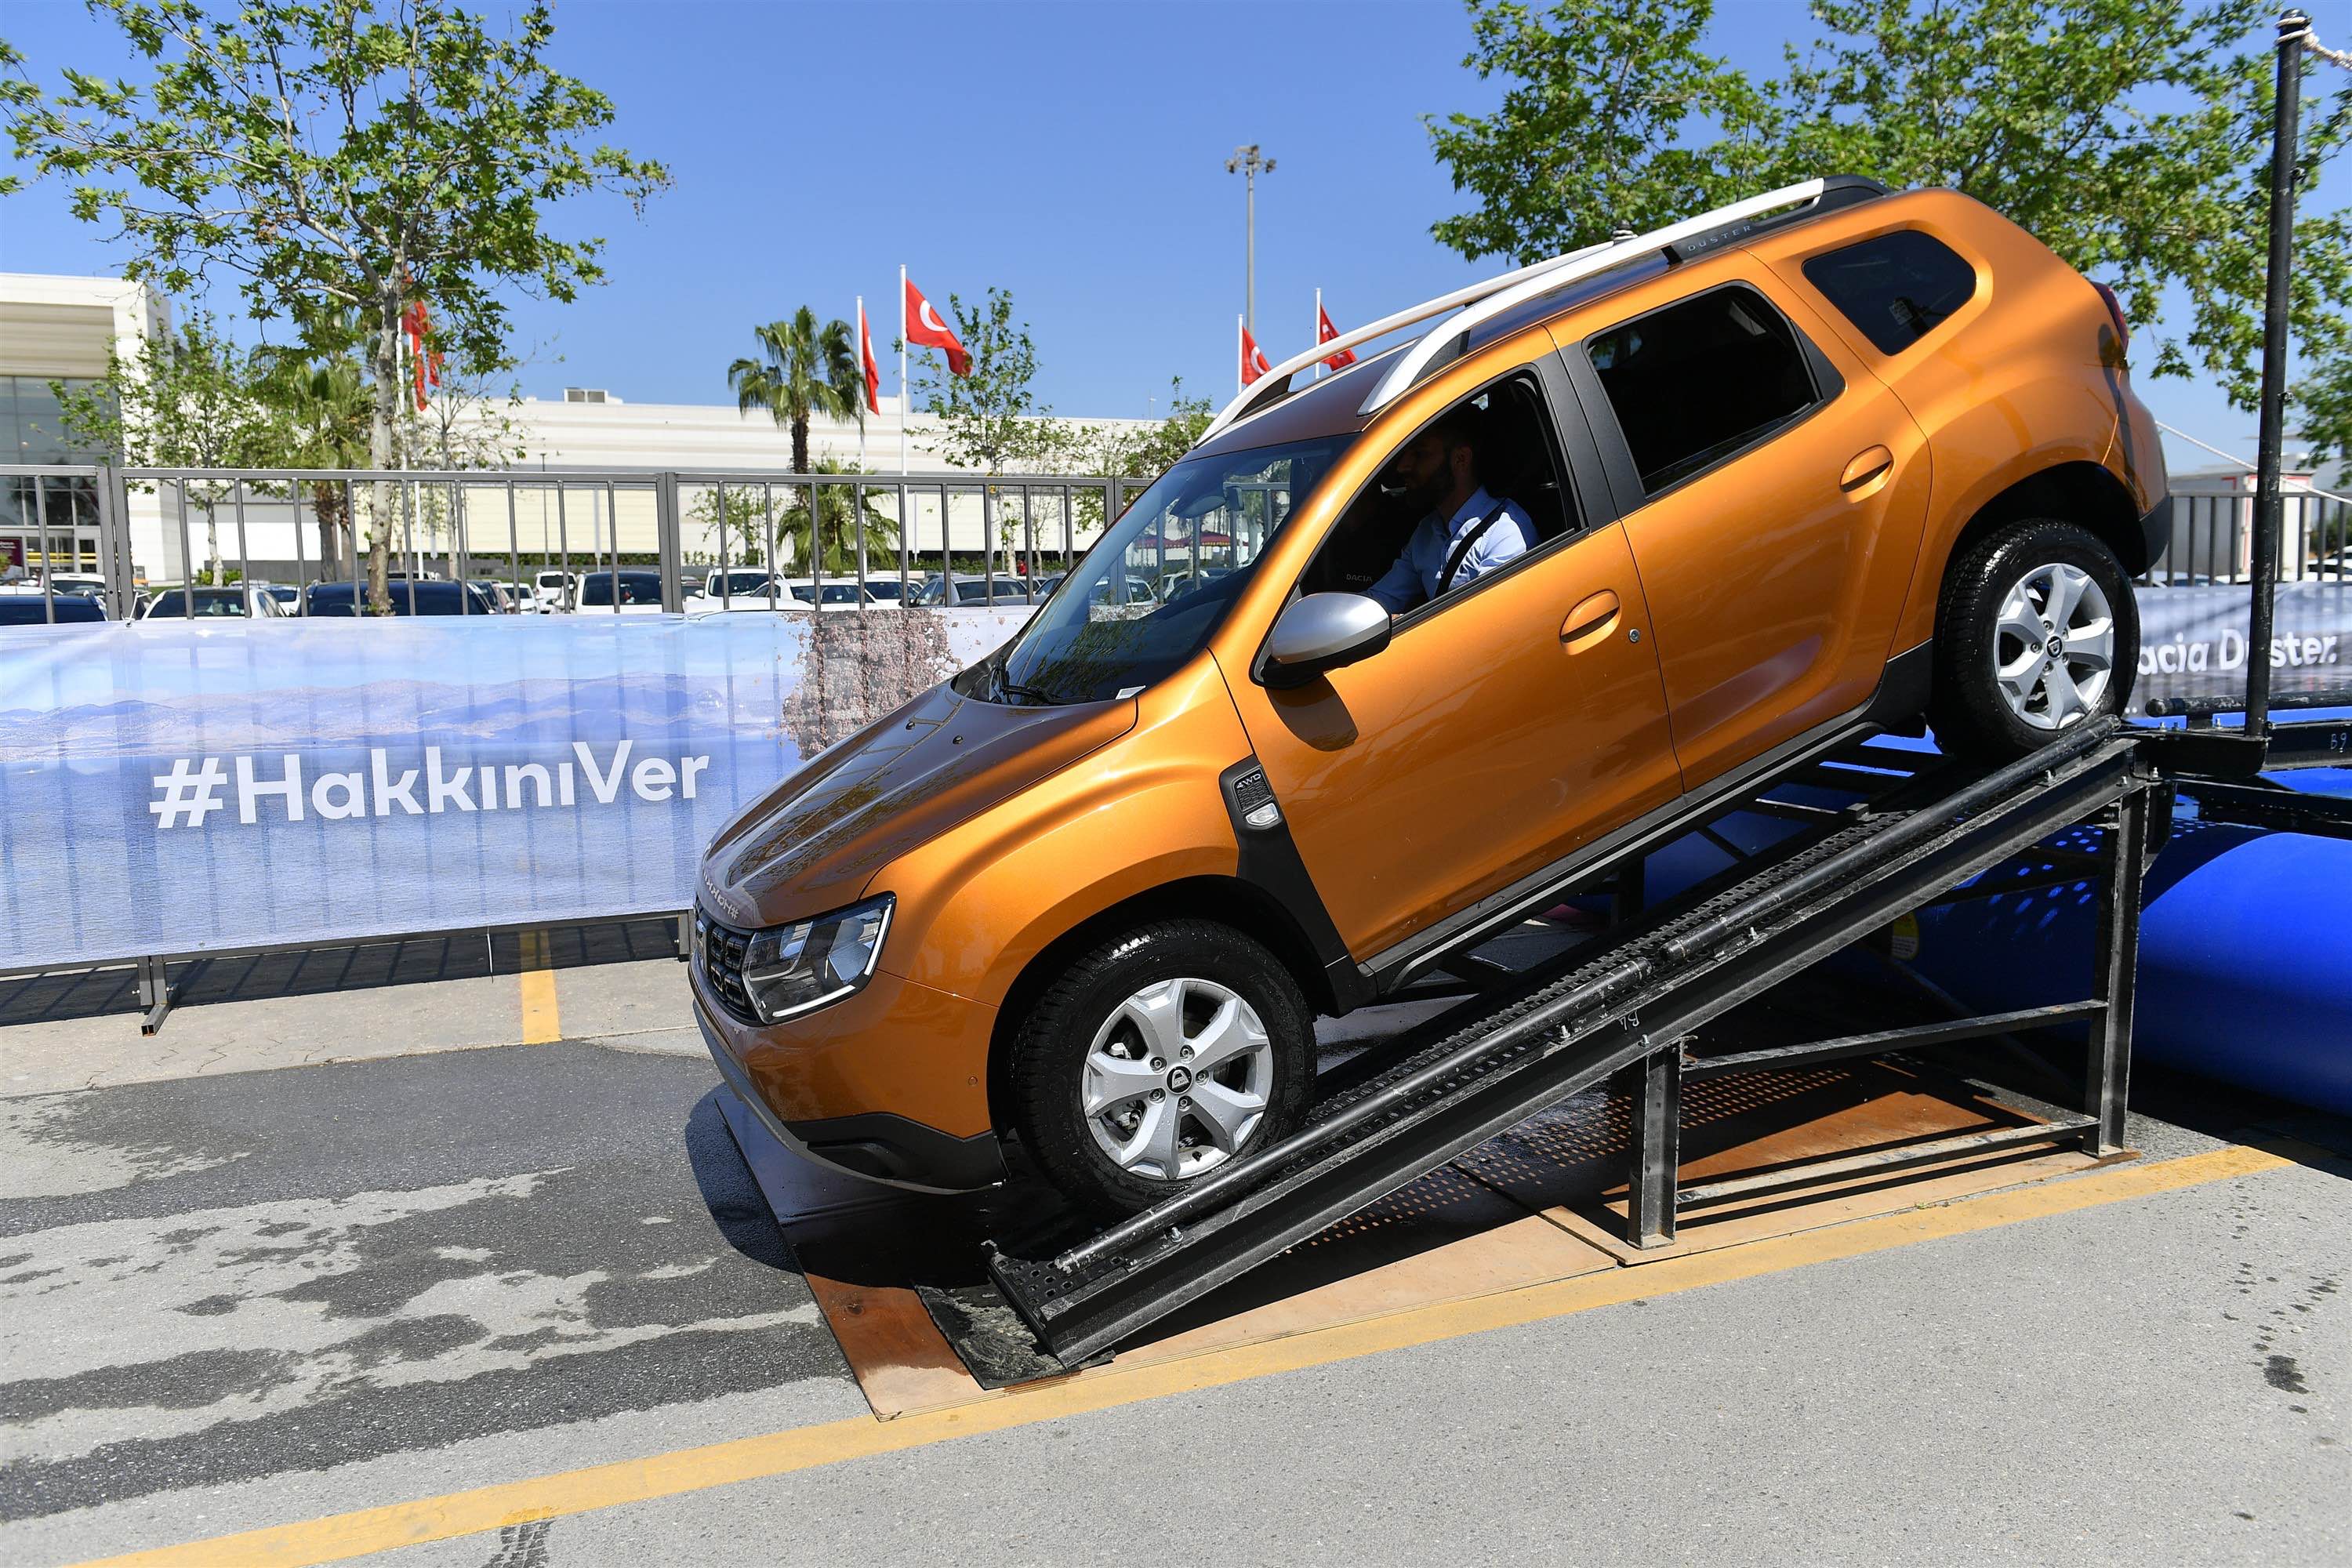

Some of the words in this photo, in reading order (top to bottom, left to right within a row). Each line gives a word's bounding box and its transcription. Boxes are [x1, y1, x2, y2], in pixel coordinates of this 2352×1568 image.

[1687, 224, 1751, 252] DUSTER
[1345, 573, 1373, 583] DACIA
[2137, 632, 2209, 675] acia
[2219, 628, 2337, 671] Dster.
[149, 739, 710, 829] #HakkınıVer
[1236, 773, 1261, 789] 4WD
